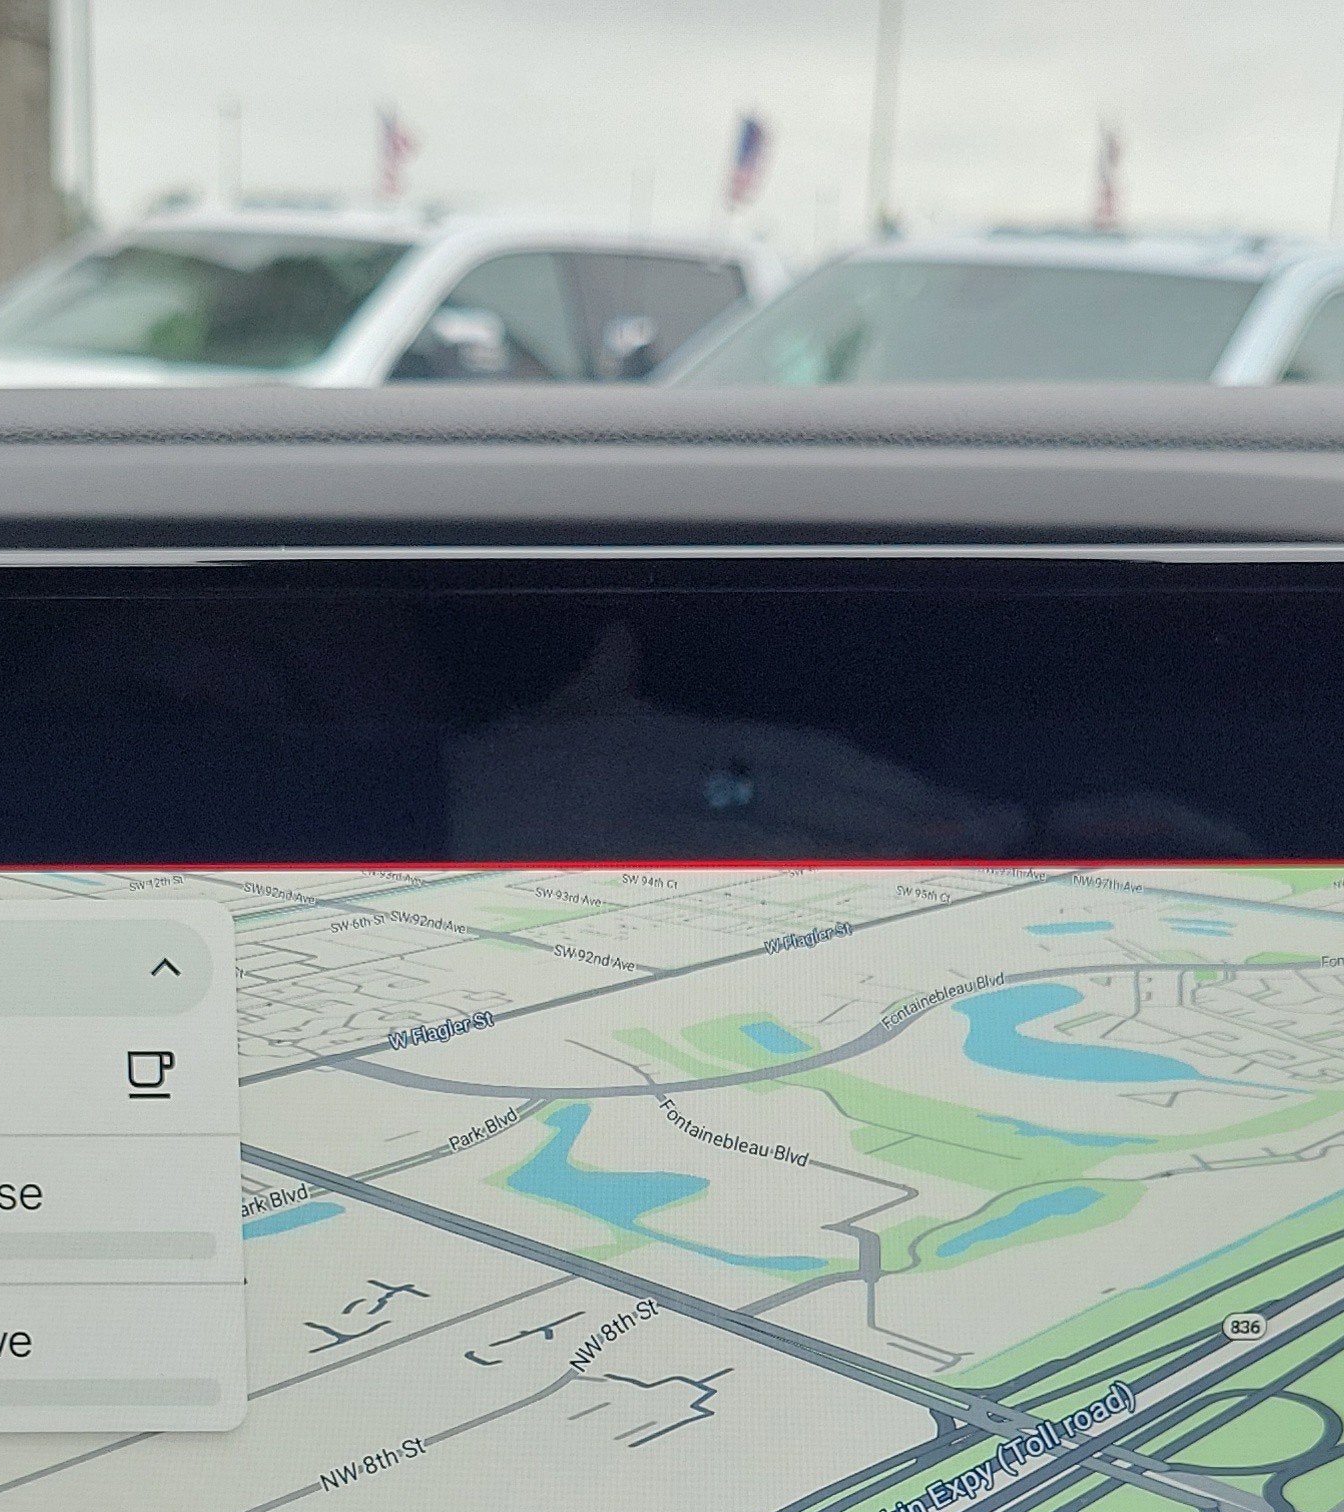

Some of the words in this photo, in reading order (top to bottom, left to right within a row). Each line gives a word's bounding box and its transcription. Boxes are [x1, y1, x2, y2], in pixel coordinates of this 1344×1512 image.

[243, 882, 265, 897] SW
[265, 886, 292, 901] 92nd
[292, 889, 316, 904] Ave
[621, 873, 639, 885] SW
[641, 875, 665, 889] 94th
[895, 885, 913, 898] SW
[1072, 874, 1093, 888] NW
[1094, 876, 1122, 891] 97th
[1123, 881, 1144, 894] Ave
[534, 886, 553, 900] SW
[555, 889, 580, 904] 93rd
[582, 894, 603, 908] Ave
[329, 921, 349, 935] SW
[352, 916, 372, 930] 6th
[372, 914, 385, 926] St
[389, 910, 411, 925] SW
[411, 914, 444, 931] 92nd
[445, 920, 467, 935] Ave
[763, 938, 781, 955] W
[834, 920, 854, 938] St
[553, 943, 575, 959] SW
[577, 948, 612, 968] 92nd
[612, 956, 636, 973] Ave
[881, 980, 973, 1030] Fontainebleau
[975, 972, 1006, 993] Blvd
[387, 1031, 410, 1051] W
[410, 1015, 471, 1047] Flagler
[472, 1010, 496, 1030] St
[448, 1124, 484, 1152] Park
[484, 1107, 520, 1136] Blvd
[658, 1098, 770, 1160] Fontainebleau
[773, 1143, 811, 1169] Blvd
[269, 1183, 310, 1209] Blvd
[568, 1334, 603, 1374] NW
[600, 1311, 637, 1344] 8th
[635, 1295, 659, 1322] St
[1229, 1318, 1261, 1336] 836
[927, 1458, 998, 1506] Expy
[996, 1420, 1062, 1477] (Toll
[1062, 1380, 1139, 1440] road)
[319, 1461, 359, 1493] NW
[362, 1446, 400, 1475] 8th
[401, 1436, 427, 1459] St
